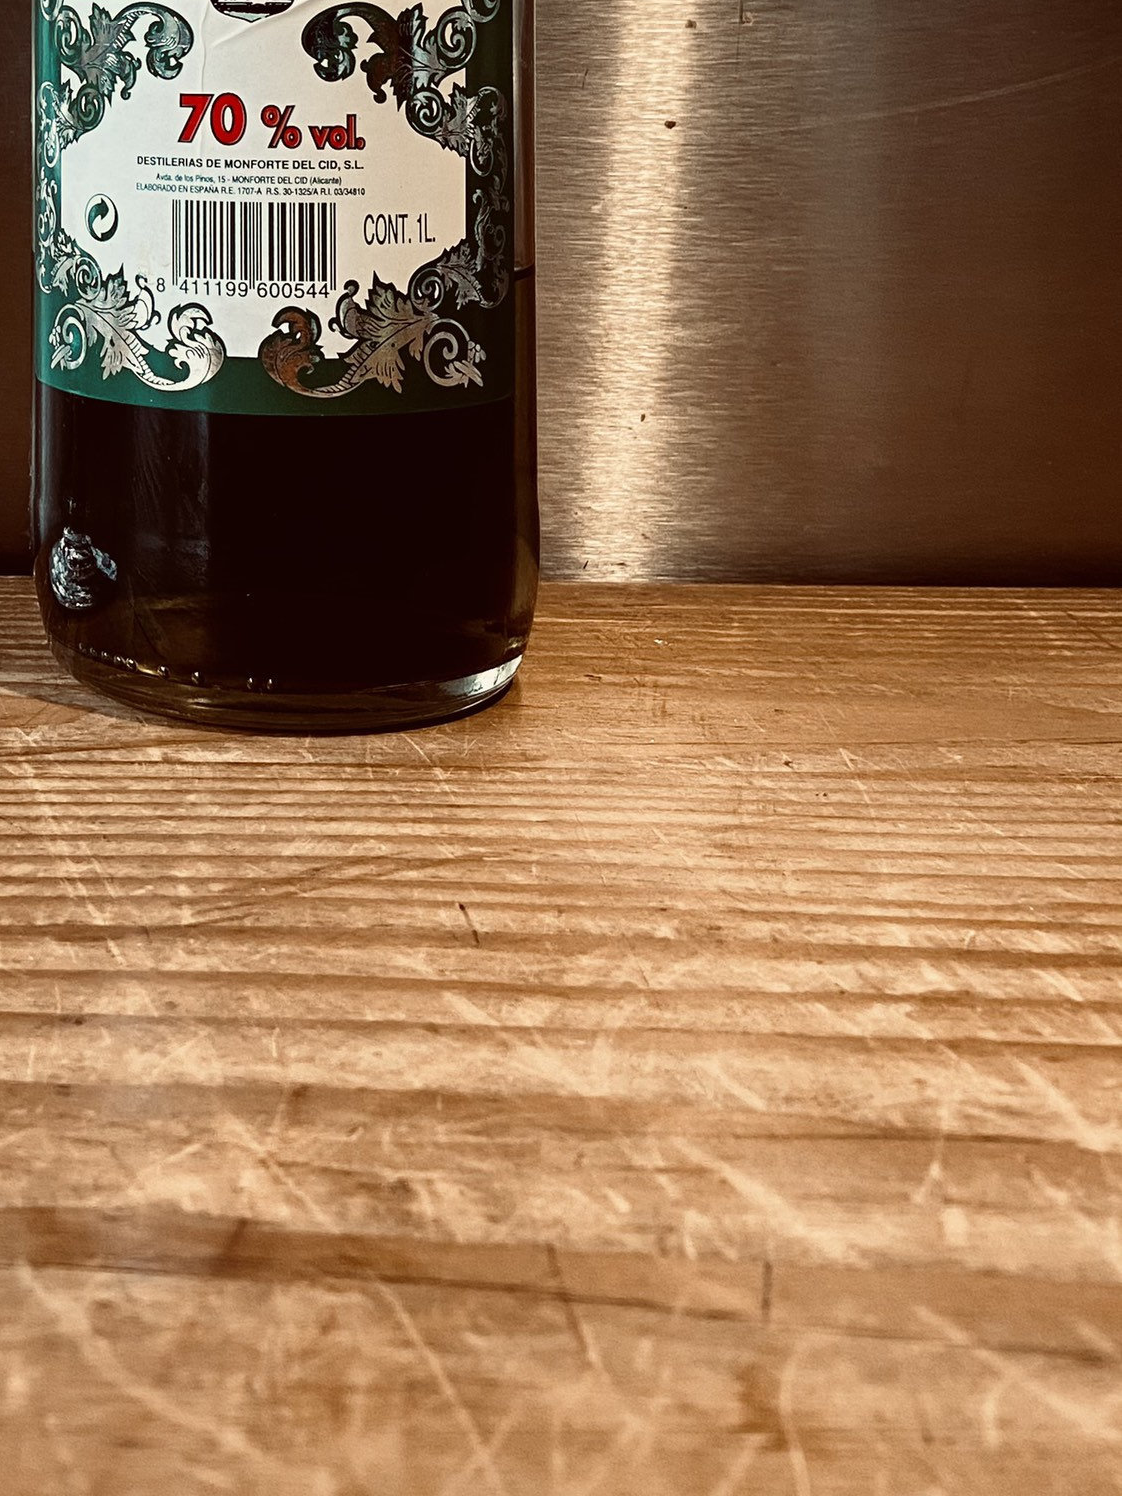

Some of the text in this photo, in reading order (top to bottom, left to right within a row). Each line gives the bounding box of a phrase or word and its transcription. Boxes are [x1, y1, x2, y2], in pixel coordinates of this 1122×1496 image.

[178, 92, 366, 150] 70 % vol.
[137, 156, 364, 171] DESTILERIAS DE MONFORTE DEL CID, S.L.
[136, 183, 177, 192] ELABORADO
[178, 184, 188, 193] EN
[190, 185, 219, 194] ESPAÑA
[184, 174, 194, 182] los
[218, 175, 226, 183] 15
[232, 176, 276, 184] MONFORTE
[278, 176, 293, 184] DEL
[294, 176, 308, 184] CID
[310, 176, 342, 186] (Alicante)
[364, 213, 436, 245] CONT. 1L.
[156, 278, 330, 298] 8 411199 600544
